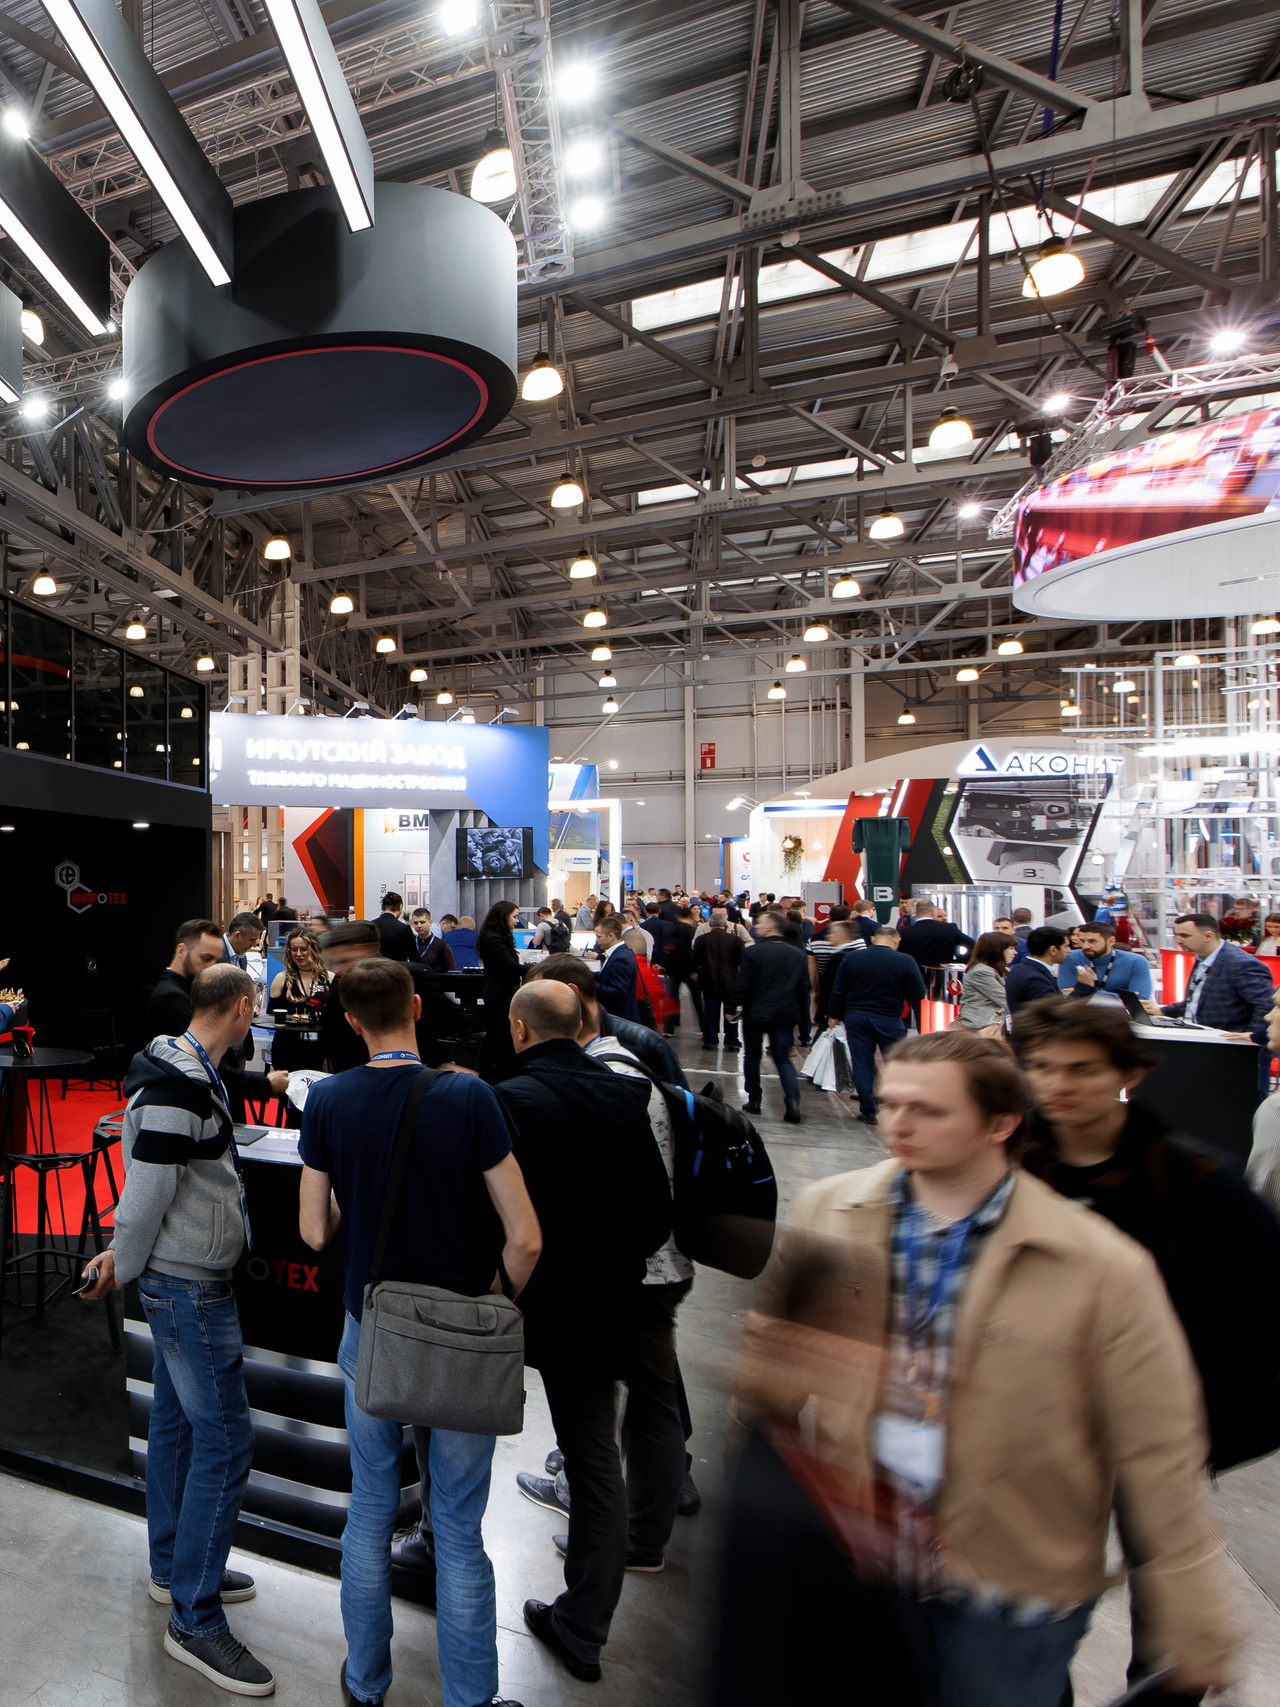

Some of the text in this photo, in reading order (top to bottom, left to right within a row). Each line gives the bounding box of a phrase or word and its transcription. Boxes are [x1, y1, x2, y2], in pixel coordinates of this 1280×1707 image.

[246, 738, 387, 764] ИРКУТСКИЙ
[390, 743, 466, 769] ЗАВОД
[72, 893, 126, 904] ИНПРОТЕХ
